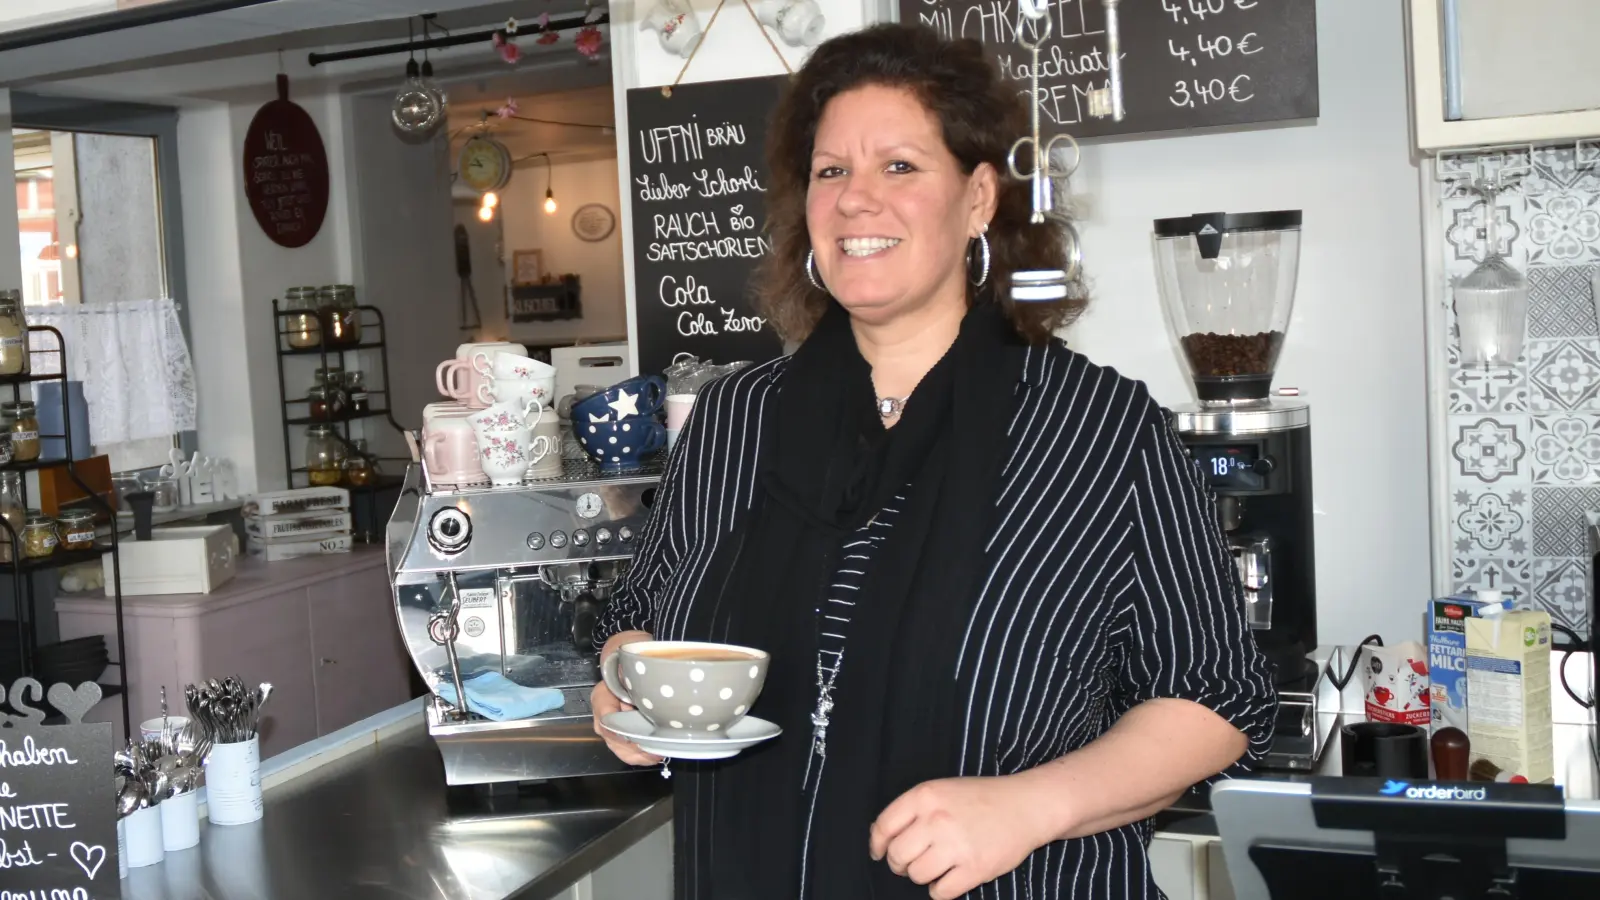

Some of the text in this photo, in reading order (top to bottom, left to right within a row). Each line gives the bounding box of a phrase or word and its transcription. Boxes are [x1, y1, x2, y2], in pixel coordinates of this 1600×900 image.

[997, 45, 1127, 80] Macchiat
[1168, 32, 1264, 67] 4,40€
[1016, 78, 1127, 125] REM
[1169, 74, 1255, 108] 3,40€
[705, 121, 748, 147] BRÄU
[653, 211, 721, 239] RAUCH
[646, 234, 776, 262] SAFTSCHORLEN
[659, 275, 717, 308] Cola
[676, 306, 767, 336] Cola Zero
[1430, 643, 1465, 658] FETTAR
[1431, 653, 1465, 672] MILC
[1405, 711, 1431, 720] ZUCKERS
[1405, 785, 1487, 801] orderbird
[0, 803, 76, 831] NETTE
